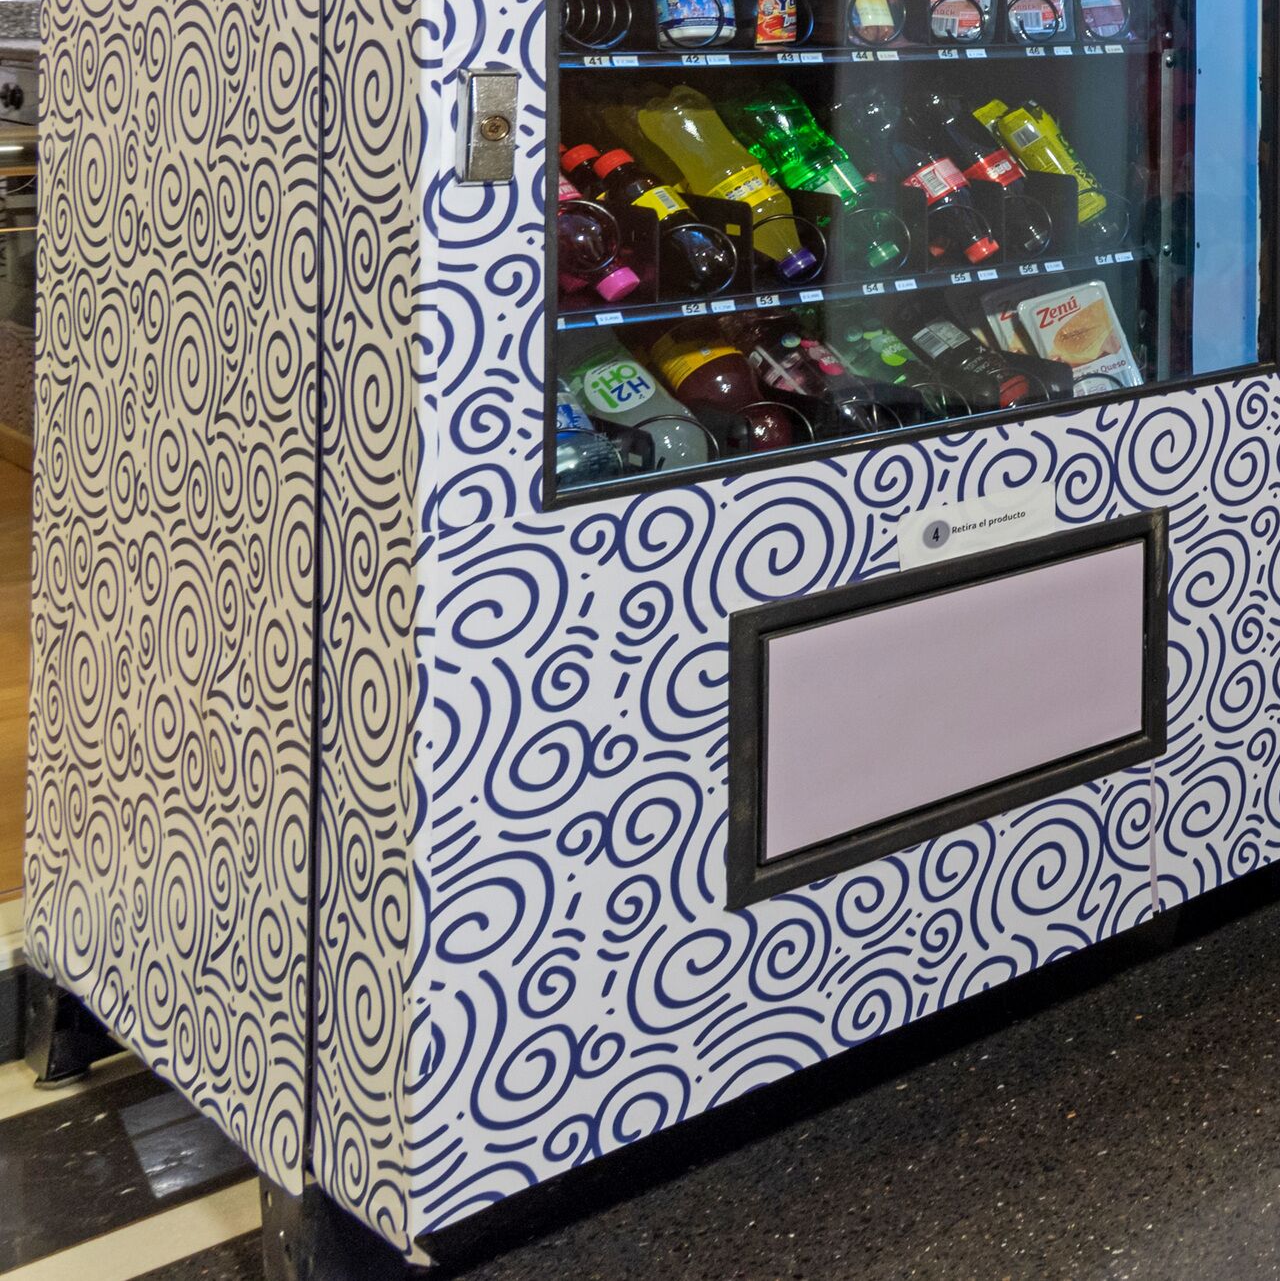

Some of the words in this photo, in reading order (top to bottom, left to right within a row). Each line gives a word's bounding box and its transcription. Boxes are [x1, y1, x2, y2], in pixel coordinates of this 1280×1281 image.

[780, 54, 794, 62] 43
[856, 52, 869, 60] 44
[942, 50, 953, 58] 45
[588, 56, 602, 65] 41
[686, 56, 699, 65] 42
[1022, 265, 1034, 274] 56
[954, 274, 967, 282] 55
[866, 284, 879, 293] 54
[759, 296, 774, 306] 53
[686, 304, 700, 314] 52
[1036, 296, 1079, 329] Zenú
[1100, 360, 1127, 374] Queso
[932, 527, 940, 542] 4
[952, 523, 977, 534] Retira
[979, 518, 987, 528] el
[989, 510, 1026, 527] producto
